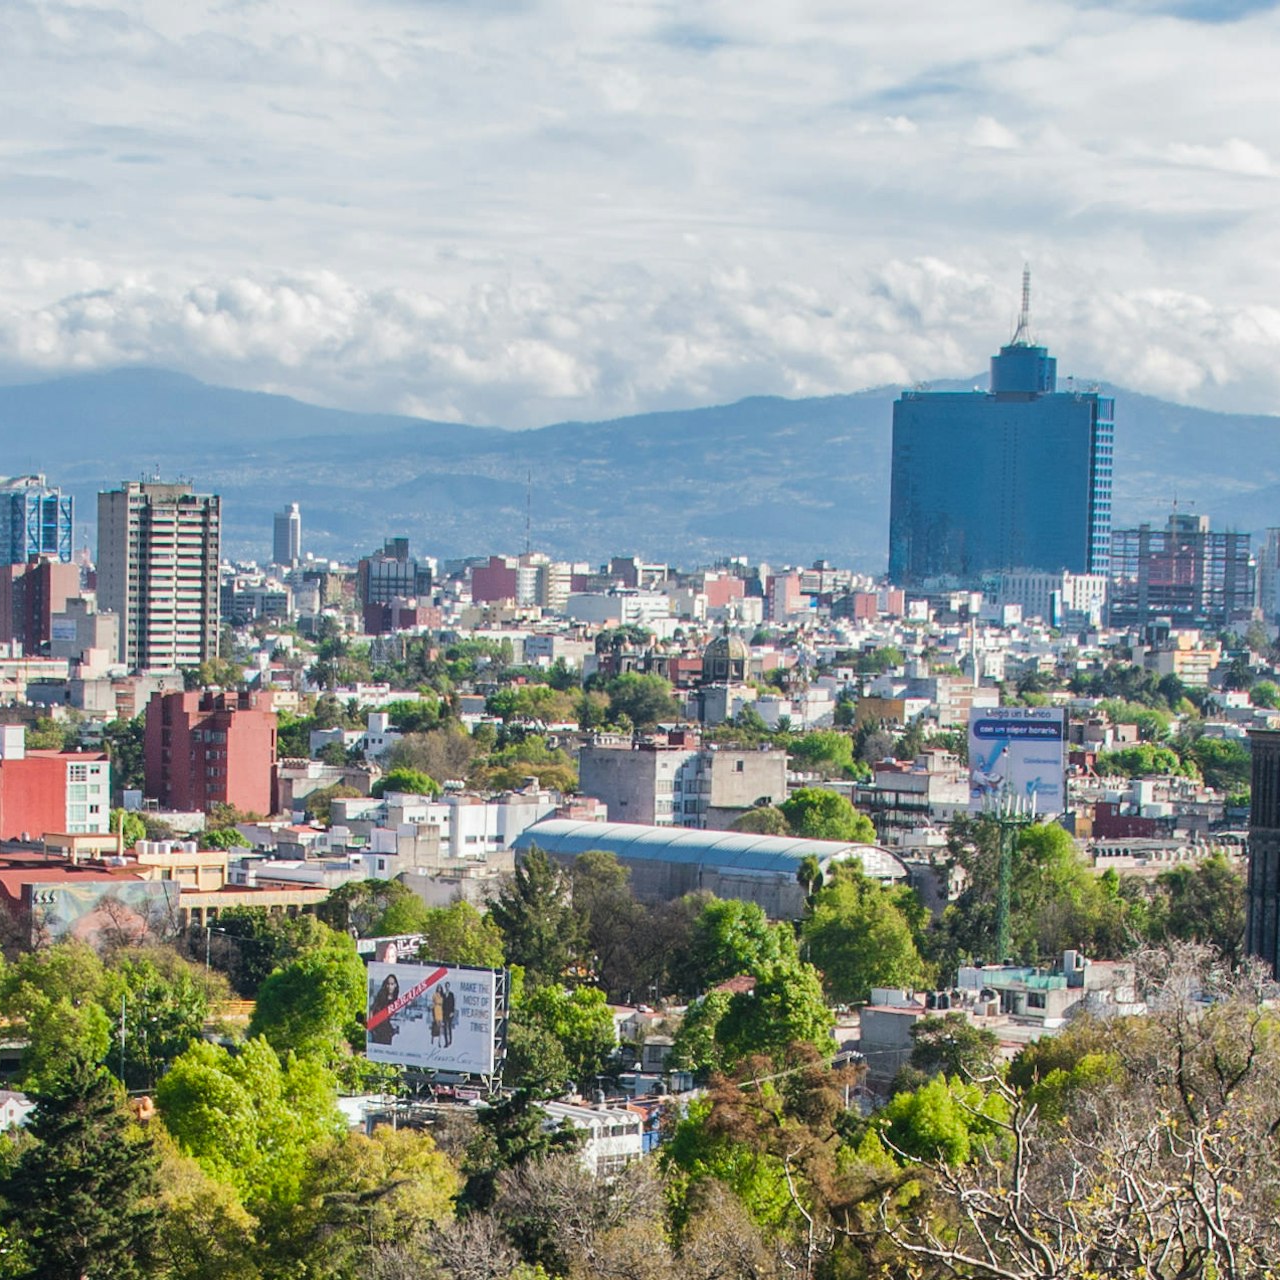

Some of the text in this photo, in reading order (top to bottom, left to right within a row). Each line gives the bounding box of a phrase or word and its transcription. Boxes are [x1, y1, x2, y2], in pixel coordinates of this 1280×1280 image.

[460, 981, 490, 994] MAKE THE
[386, 980, 428, 1015] REBAJAS
[463, 994, 489, 1006] MOST OF
[460, 1007, 489, 1019] WEARING
